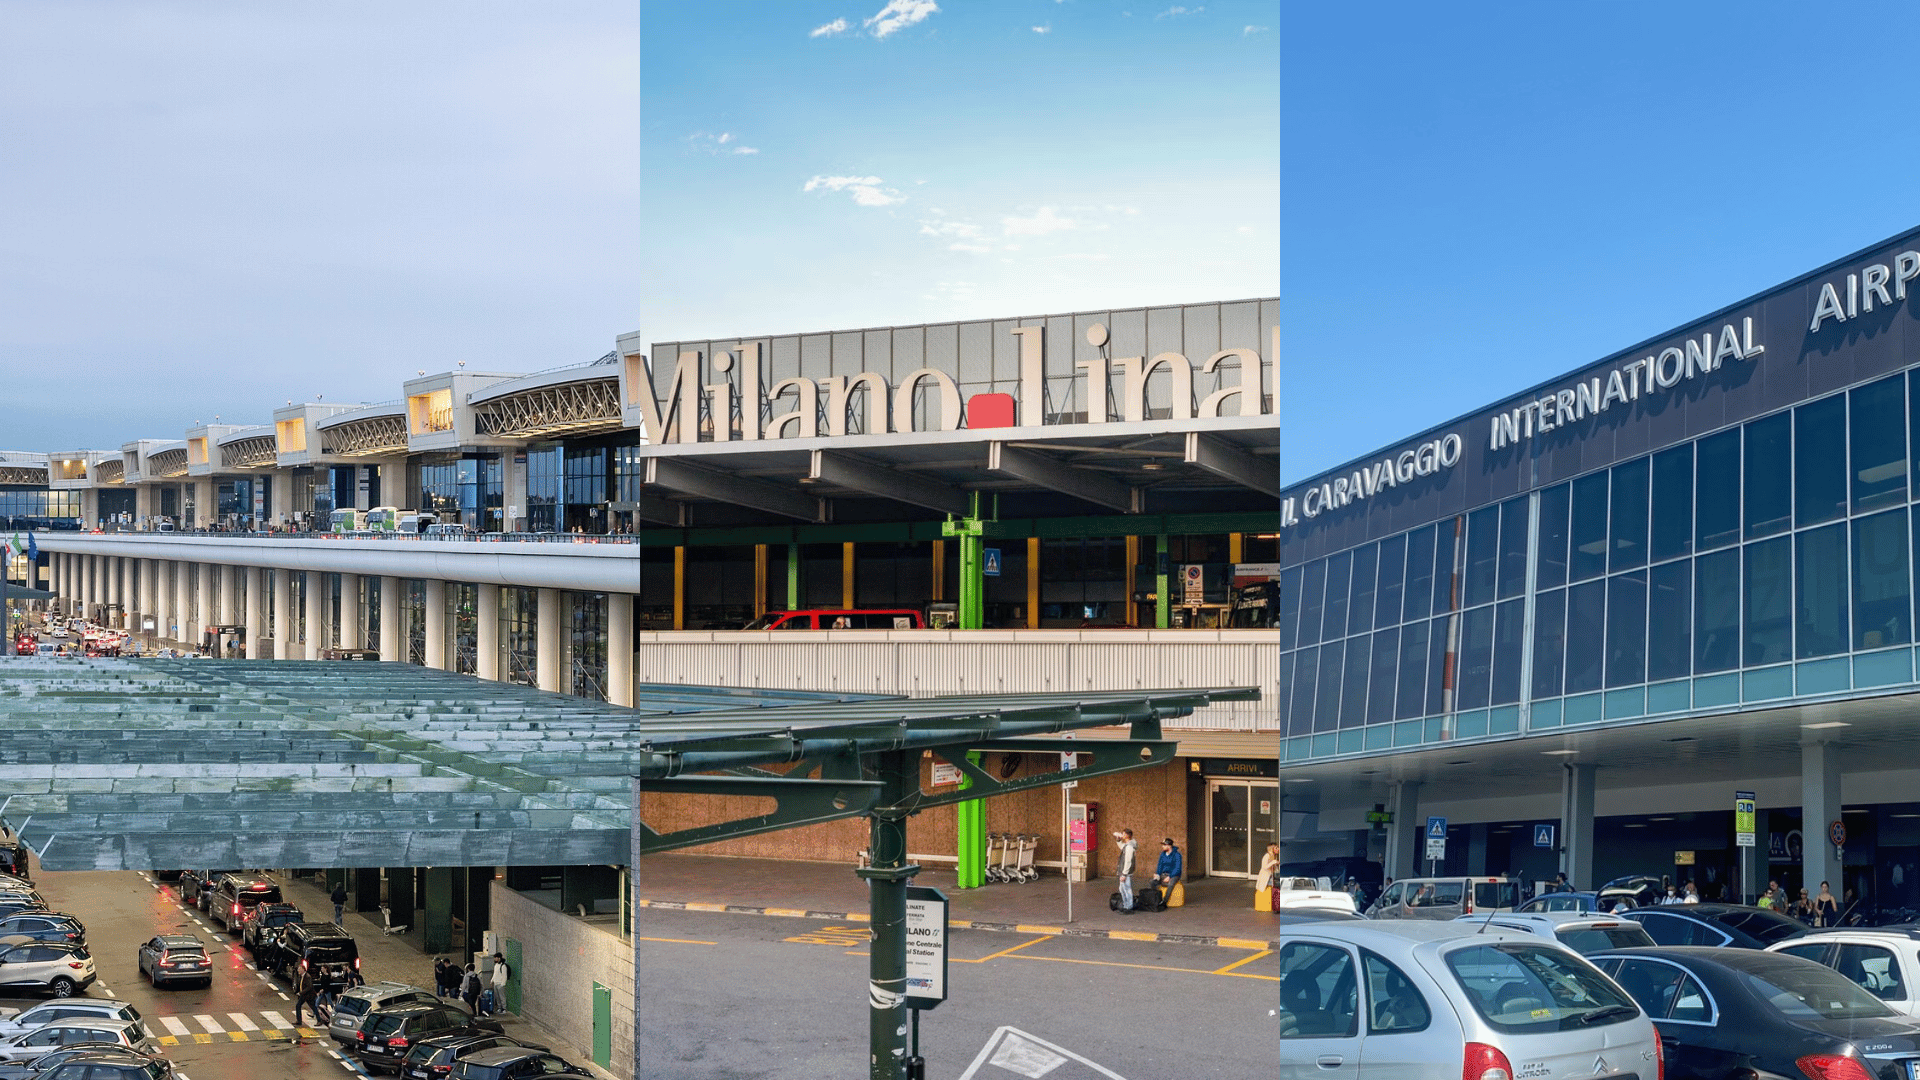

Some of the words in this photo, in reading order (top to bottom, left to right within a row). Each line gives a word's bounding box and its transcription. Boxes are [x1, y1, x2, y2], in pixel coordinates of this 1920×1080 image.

[640, 341, 963, 445] Milano
[1280, 497, 1299, 528] IL
[1302, 433, 1462, 518] CARAVAGGIO
[1489, 316, 1766, 451] INTERNATIONAL
[1227, 763, 1258, 774] ARRIVI
[916, 940, 942, 949] Centrale
[912, 948, 935, 957] Station
